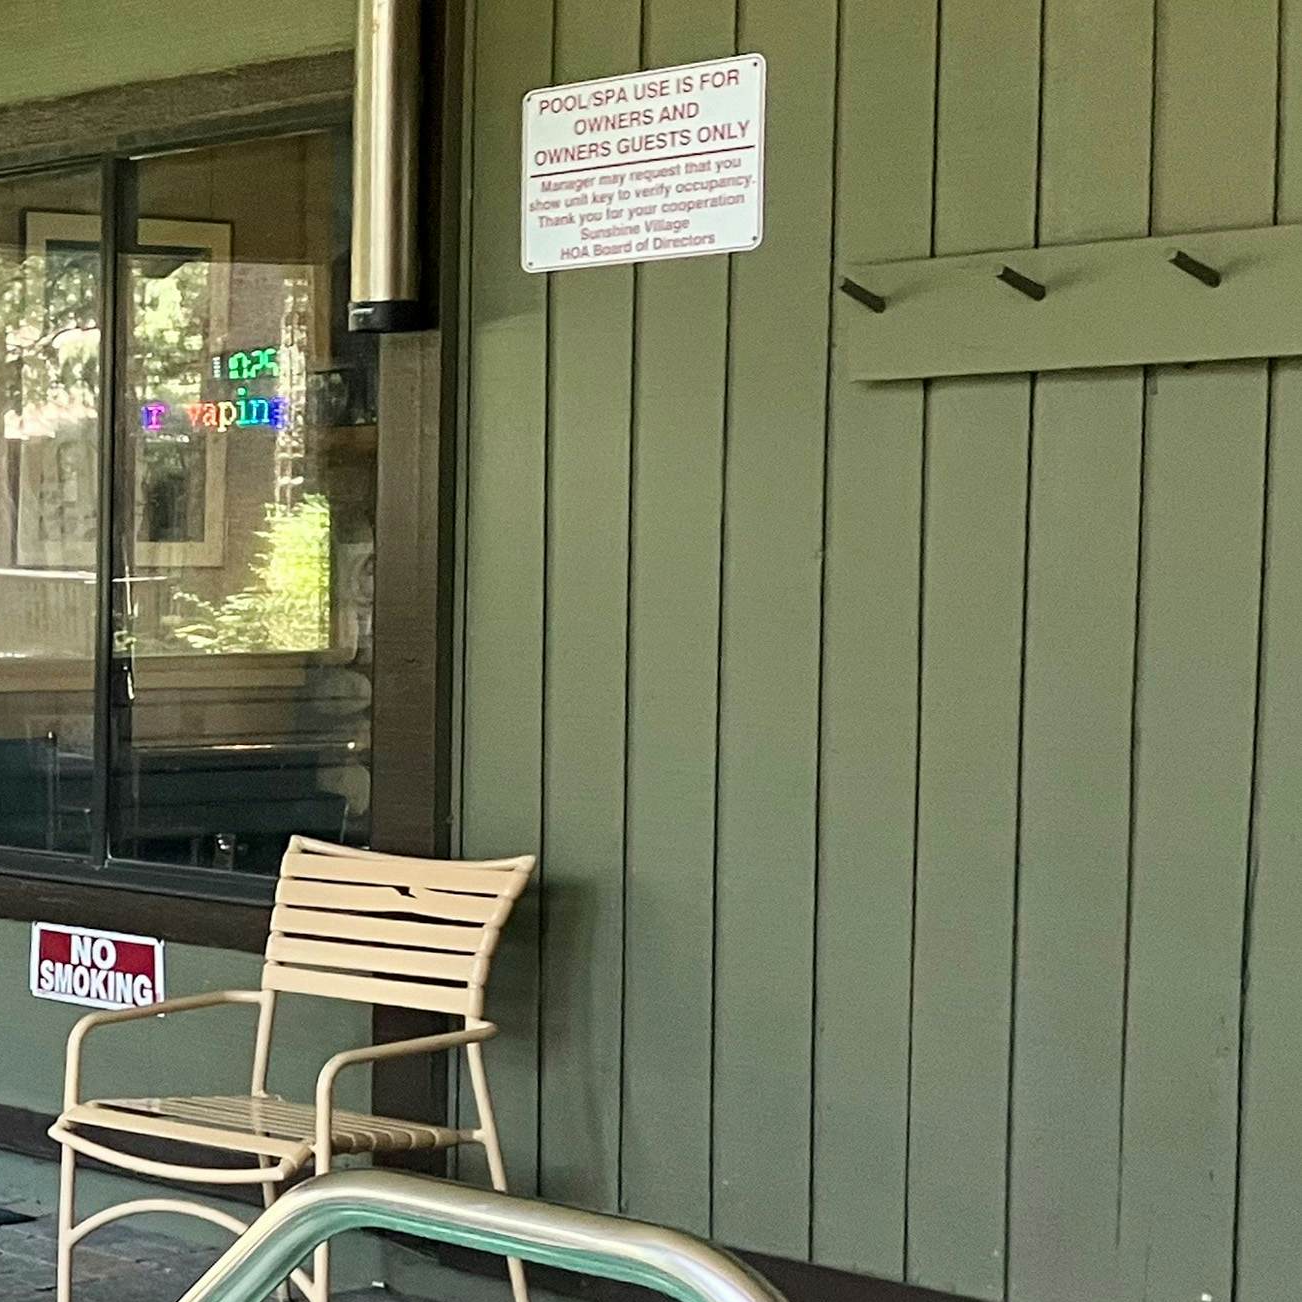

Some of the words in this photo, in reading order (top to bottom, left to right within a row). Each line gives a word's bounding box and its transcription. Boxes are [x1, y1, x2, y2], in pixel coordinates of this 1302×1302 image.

[539, 87, 628, 115] POOL/SPA
[634, 79, 670, 100] USE
[676, 76, 694, 94] IS
[700, 69, 740, 91] FOR
[574, 109, 654, 135] OWNERS
[658, 102, 700, 121] AND
[534, 141, 612, 166] OWNERS
[617, 129, 692, 154] GUESTS
[697, 120, 750, 143] ONLY
[541, 177, 596, 193] Manager
[599, 173, 626, 186] may
[629, 164, 681, 182] request
[685, 160, 712, 174] that
[715, 158, 742, 173] you
[529, 199, 560, 212] show
[564, 193, 589, 208] unit
[591, 191, 615, 205] key
[617, 189, 631, 200] to
[635, 183, 671, 198] verify
[538, 212, 576, 228] Thank
[579, 212, 603, 226] you
[606, 207, 624, 220] for
[628, 205, 657, 220] your
[661, 194, 745, 213] cooperation
[581, 223, 641, 240] Sunshine
[645, 219, 690, 233] Village
[560, 245, 590, 260] HOA
[593, 241, 632, 256] Board
[635, 238, 650, 252] of
[653, 234, 716, 250] Directors
[70, 934, 117, 970] NO
[39, 959, 154, 1007] SMOKING
